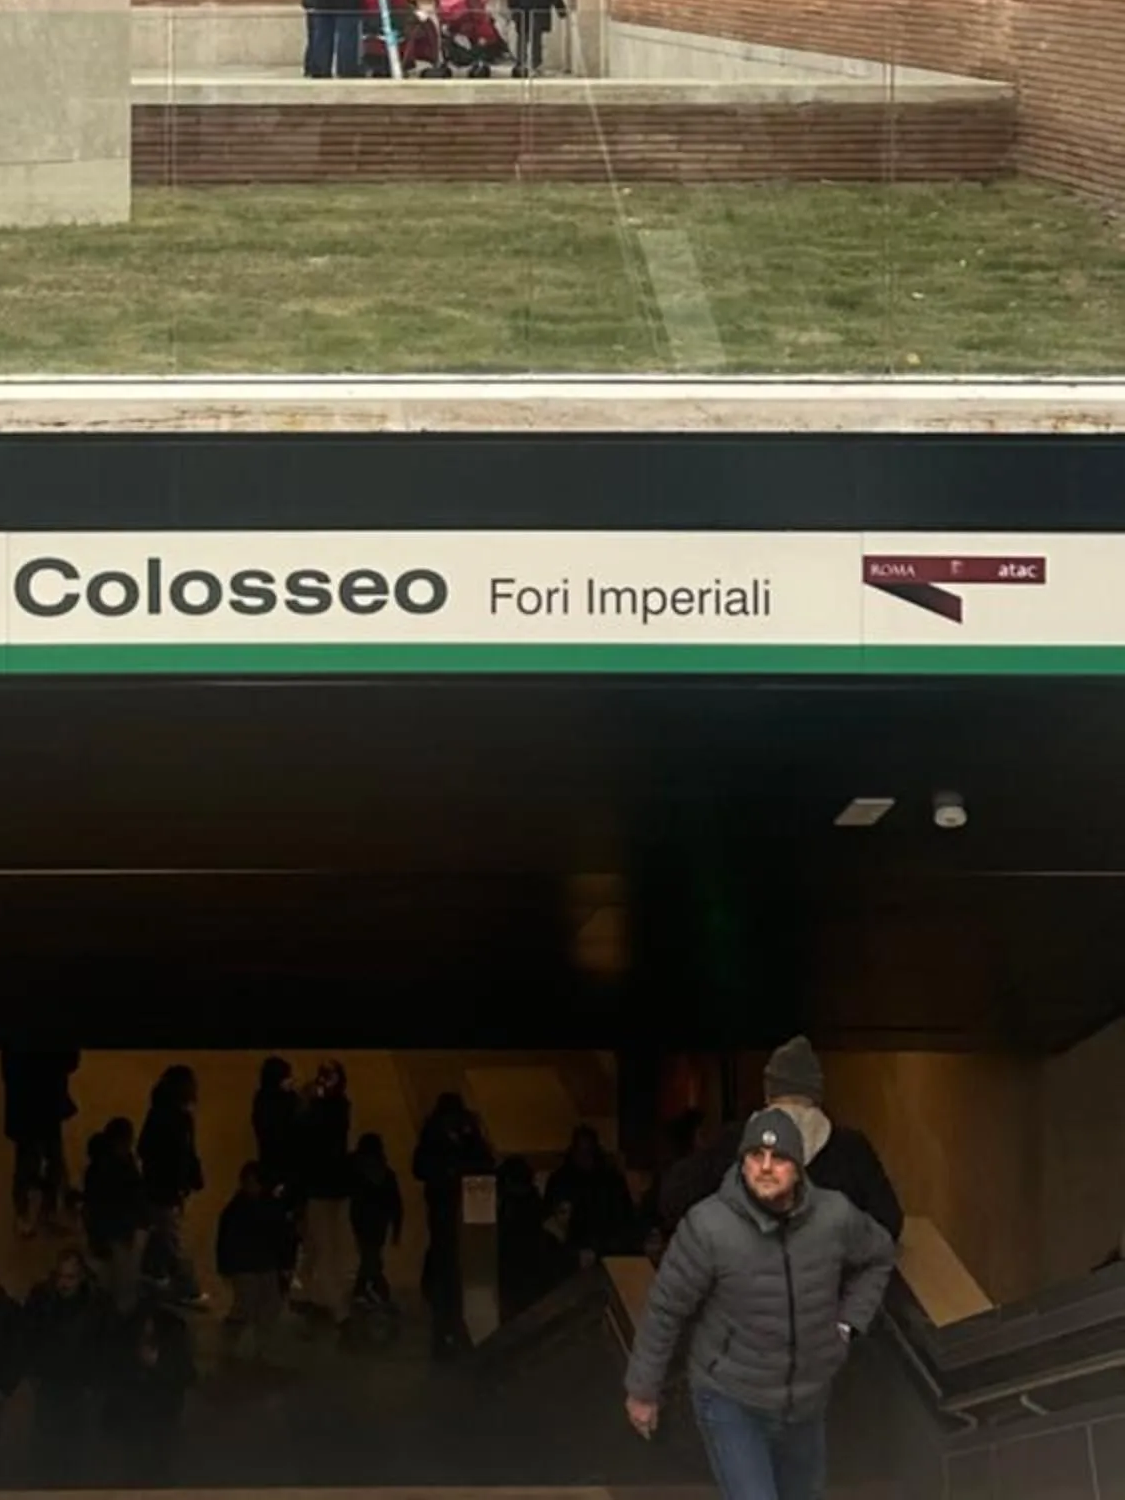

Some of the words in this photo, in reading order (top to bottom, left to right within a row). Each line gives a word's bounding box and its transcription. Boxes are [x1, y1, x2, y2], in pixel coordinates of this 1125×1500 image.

[870, 562, 916, 578] ROMA
[997, 562, 1038, 579] atac
[13, 557, 449, 617] Colosseo
[489, 577, 570, 616] Fori
[588, 577, 771, 625] Imperiali
